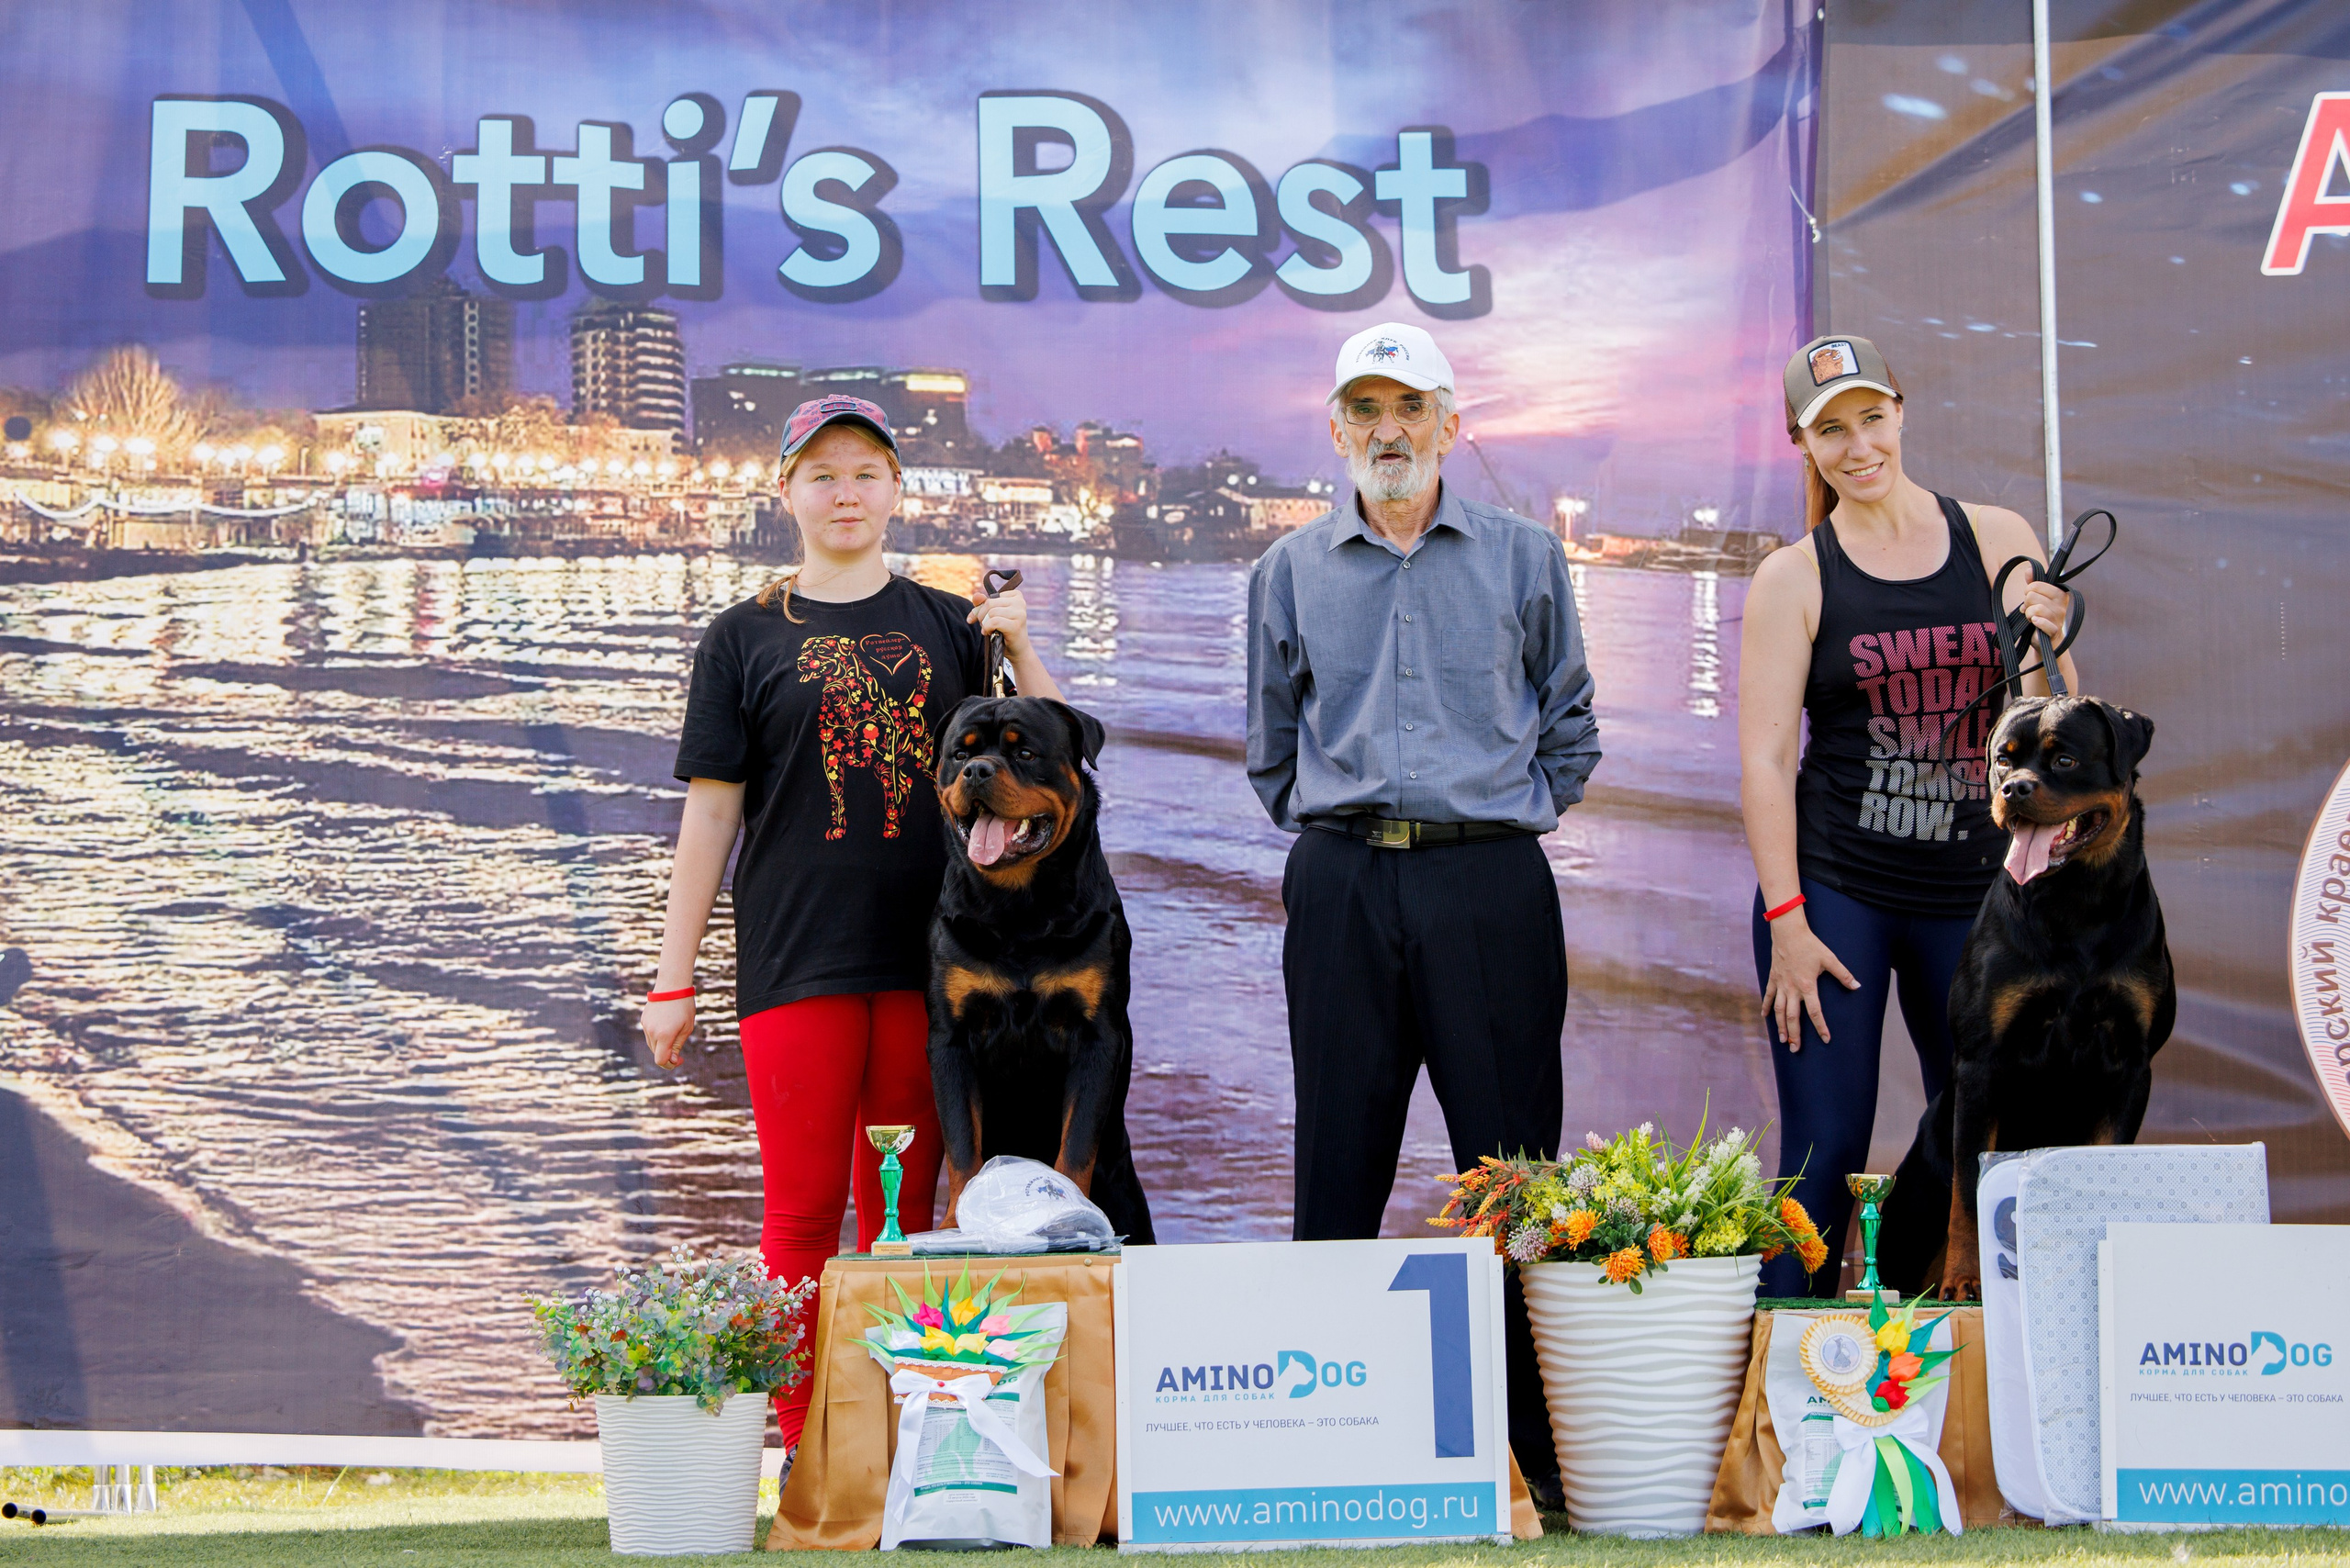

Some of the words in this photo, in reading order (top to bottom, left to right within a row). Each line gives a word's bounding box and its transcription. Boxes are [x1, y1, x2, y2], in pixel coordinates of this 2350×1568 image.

[977, 95, 1472, 305] Rest
[1858, 790, 1969, 842] ROW.
[1387, 1252, 1475, 1459] 1
[2183, 1369, 2205, 1377] ДЛЯ
[1156, 1395, 1197, 1404] КОРМА
[1235, 1393, 1275, 1401] СОБАК
[2131, 1393, 2172, 1403] ЛУЧШЕЕ,
[2175, 1393, 2193, 1402] ЧТО
[2195, 1393, 2218, 1402] ЕСТЬ
[2220, 1394, 2225, 1402] У
[2228, 1394, 2277, 1403] ЧЕЛОВЕКА
[2287, 1394, 2304, 1403] ЭТО
[2307, 1394, 2344, 1403] СОБАКА
[1146, 1422, 1192, 1433] ЛУЧШЕЕ,
[1193, 1421, 1214, 1431] ЧТО
[1216, 1419, 1242, 1430] ЕСТЬ
[1243, 1419, 1250, 1429] У
[1252, 1418, 1306, 1429] ЧЕЛОВЕКА
[1316, 1417, 1337, 1428] ЭТО
[1339, 1416, 1380, 1427] СОБАКА
[1154, 1491, 1479, 1529] www.aminodog.ru
